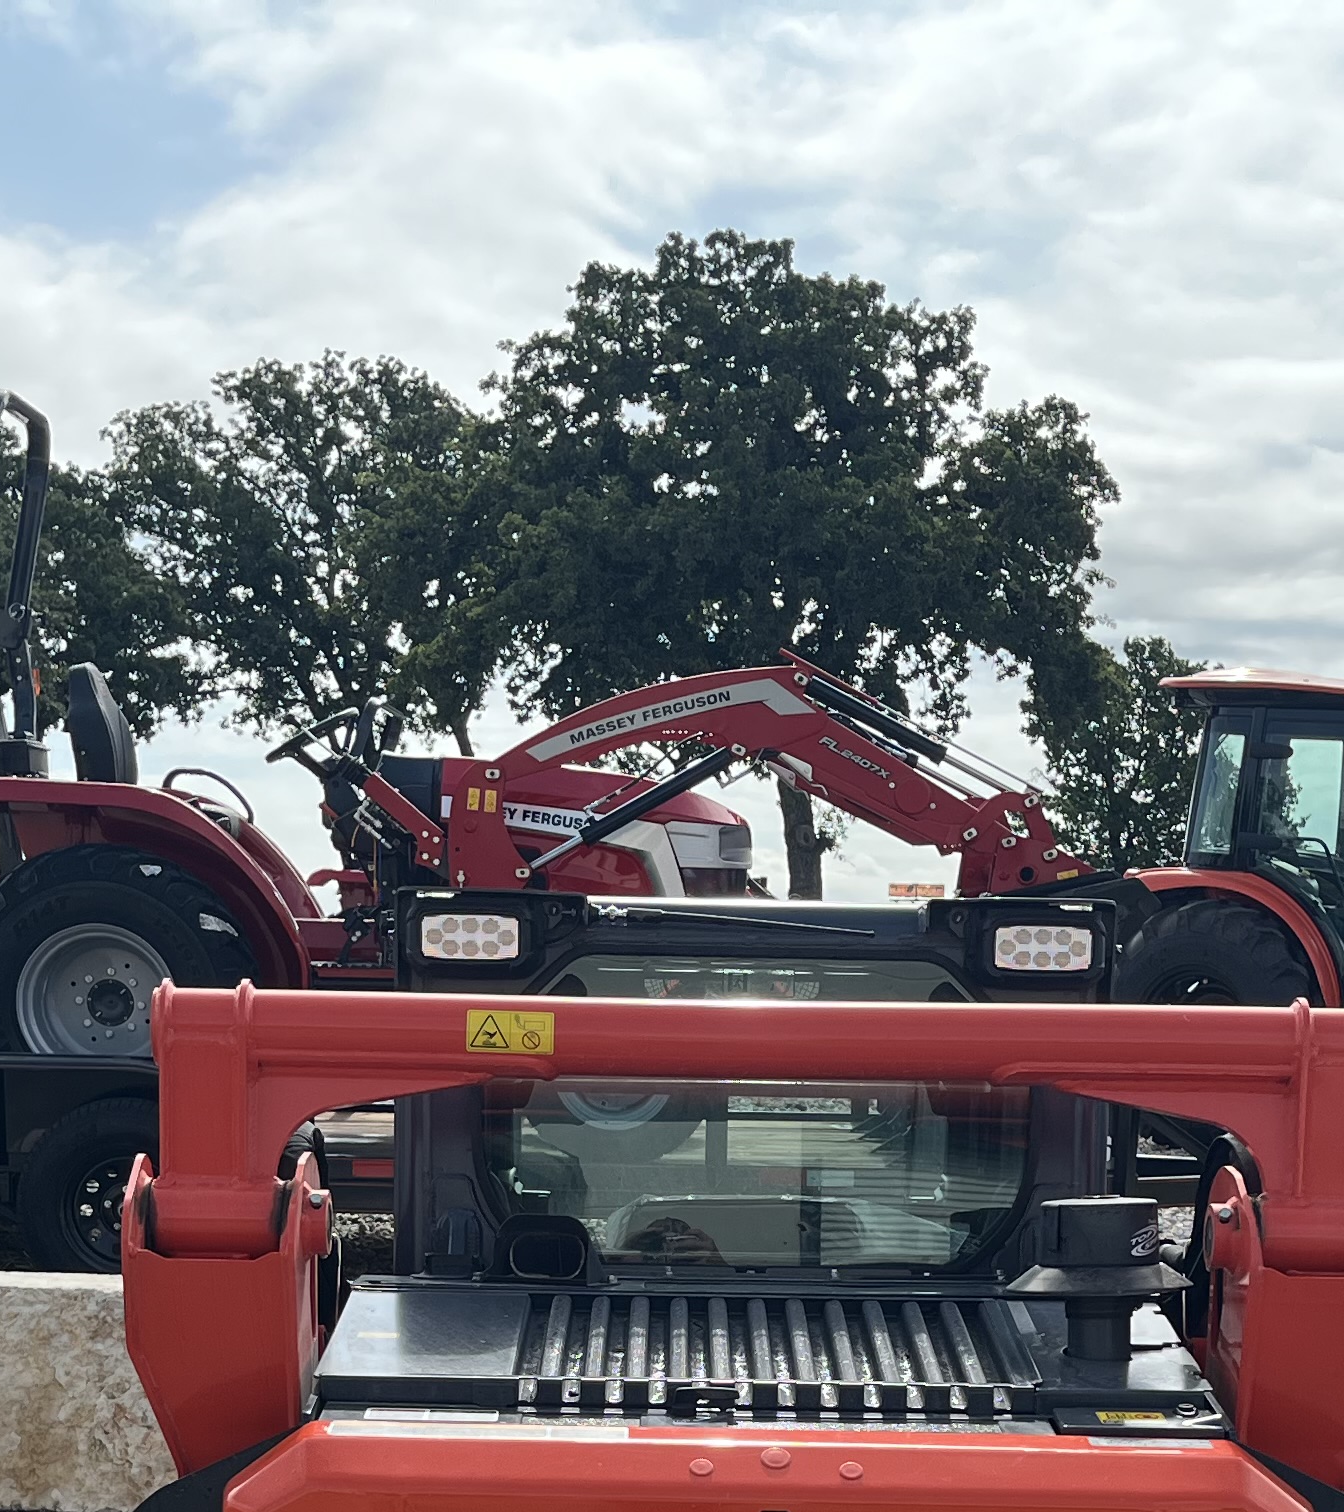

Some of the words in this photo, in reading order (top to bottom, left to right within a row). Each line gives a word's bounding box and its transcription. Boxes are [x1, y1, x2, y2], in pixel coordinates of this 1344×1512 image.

[569, 713, 638, 745] MASSEY
[642, 690, 732, 722] FERGUSON
[818, 735, 891, 779] FL2407X
[522, 809, 590, 830] FERGUS
